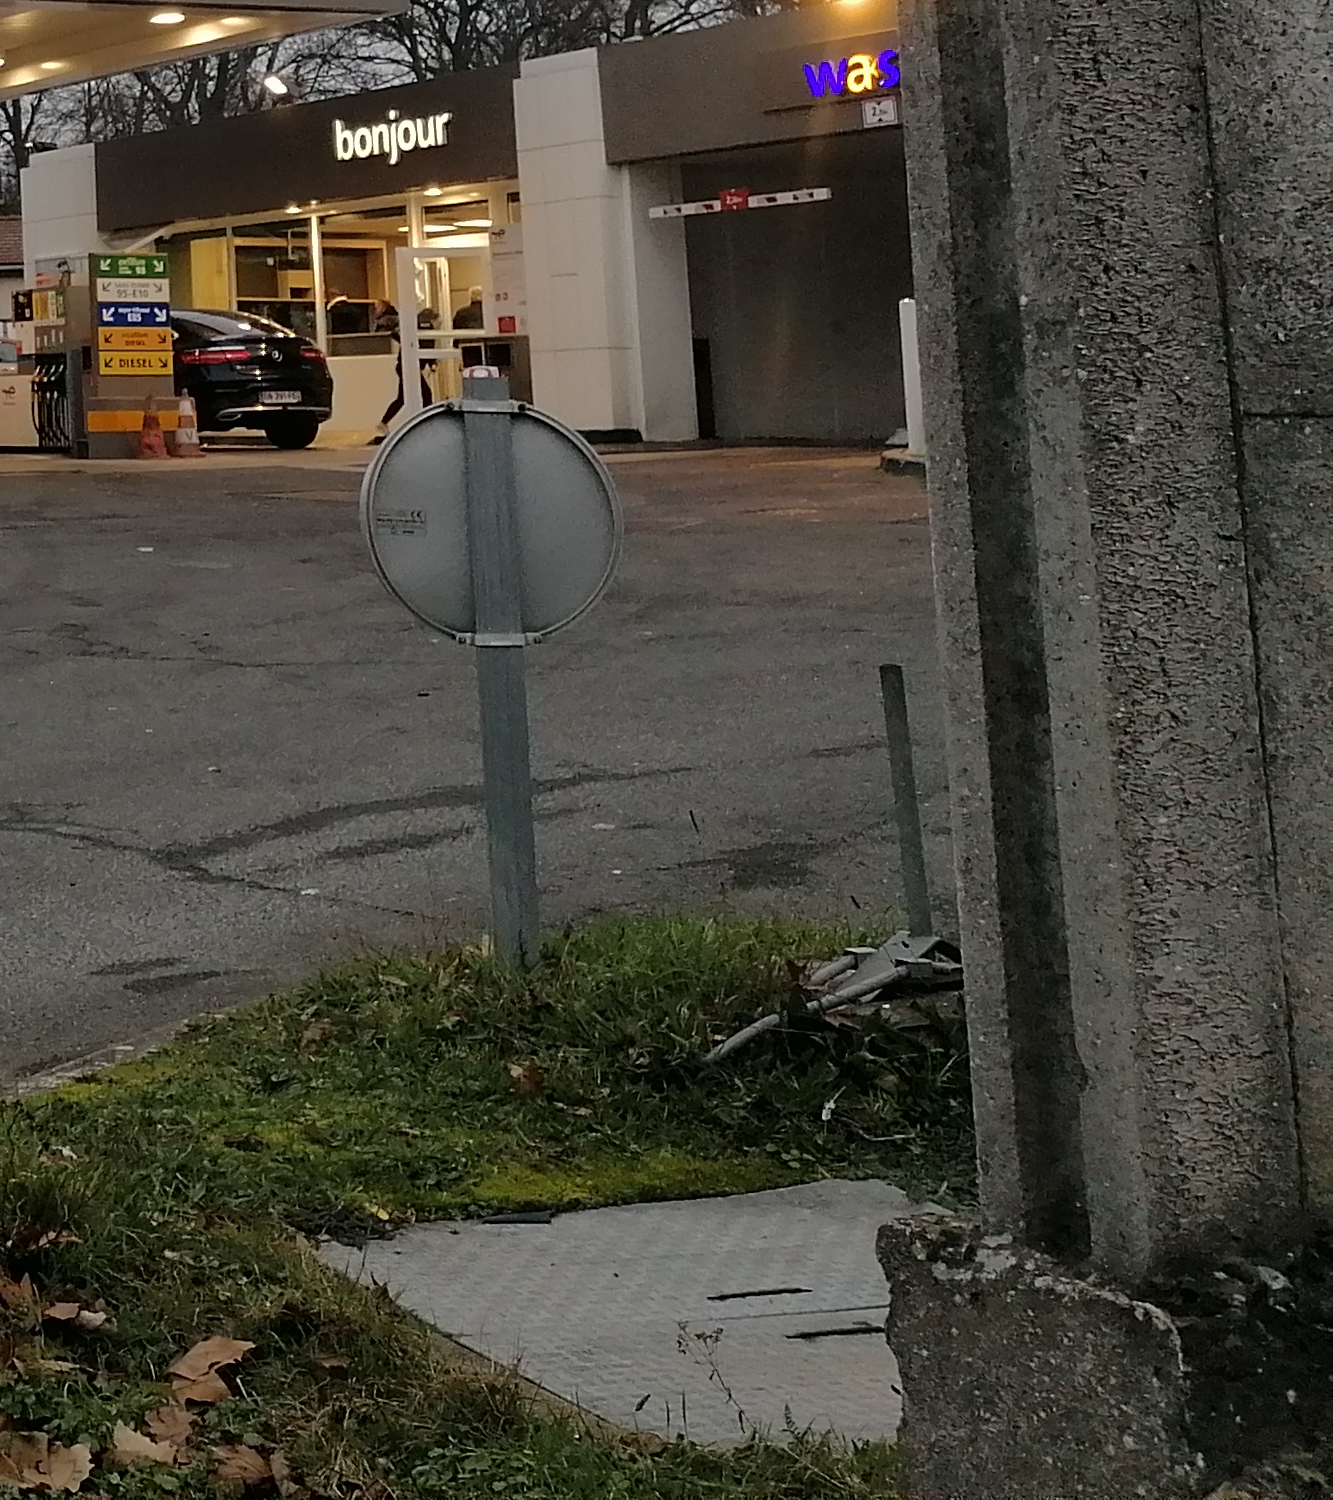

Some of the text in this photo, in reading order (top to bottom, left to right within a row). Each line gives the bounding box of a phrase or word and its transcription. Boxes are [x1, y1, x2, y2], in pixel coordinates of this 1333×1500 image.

[803, 49, 900, 97] was
[333, 109, 453, 165] bonjour
[116, 289, 149, 299] 95-E10
[119, 358, 153, 368] DIESEL
